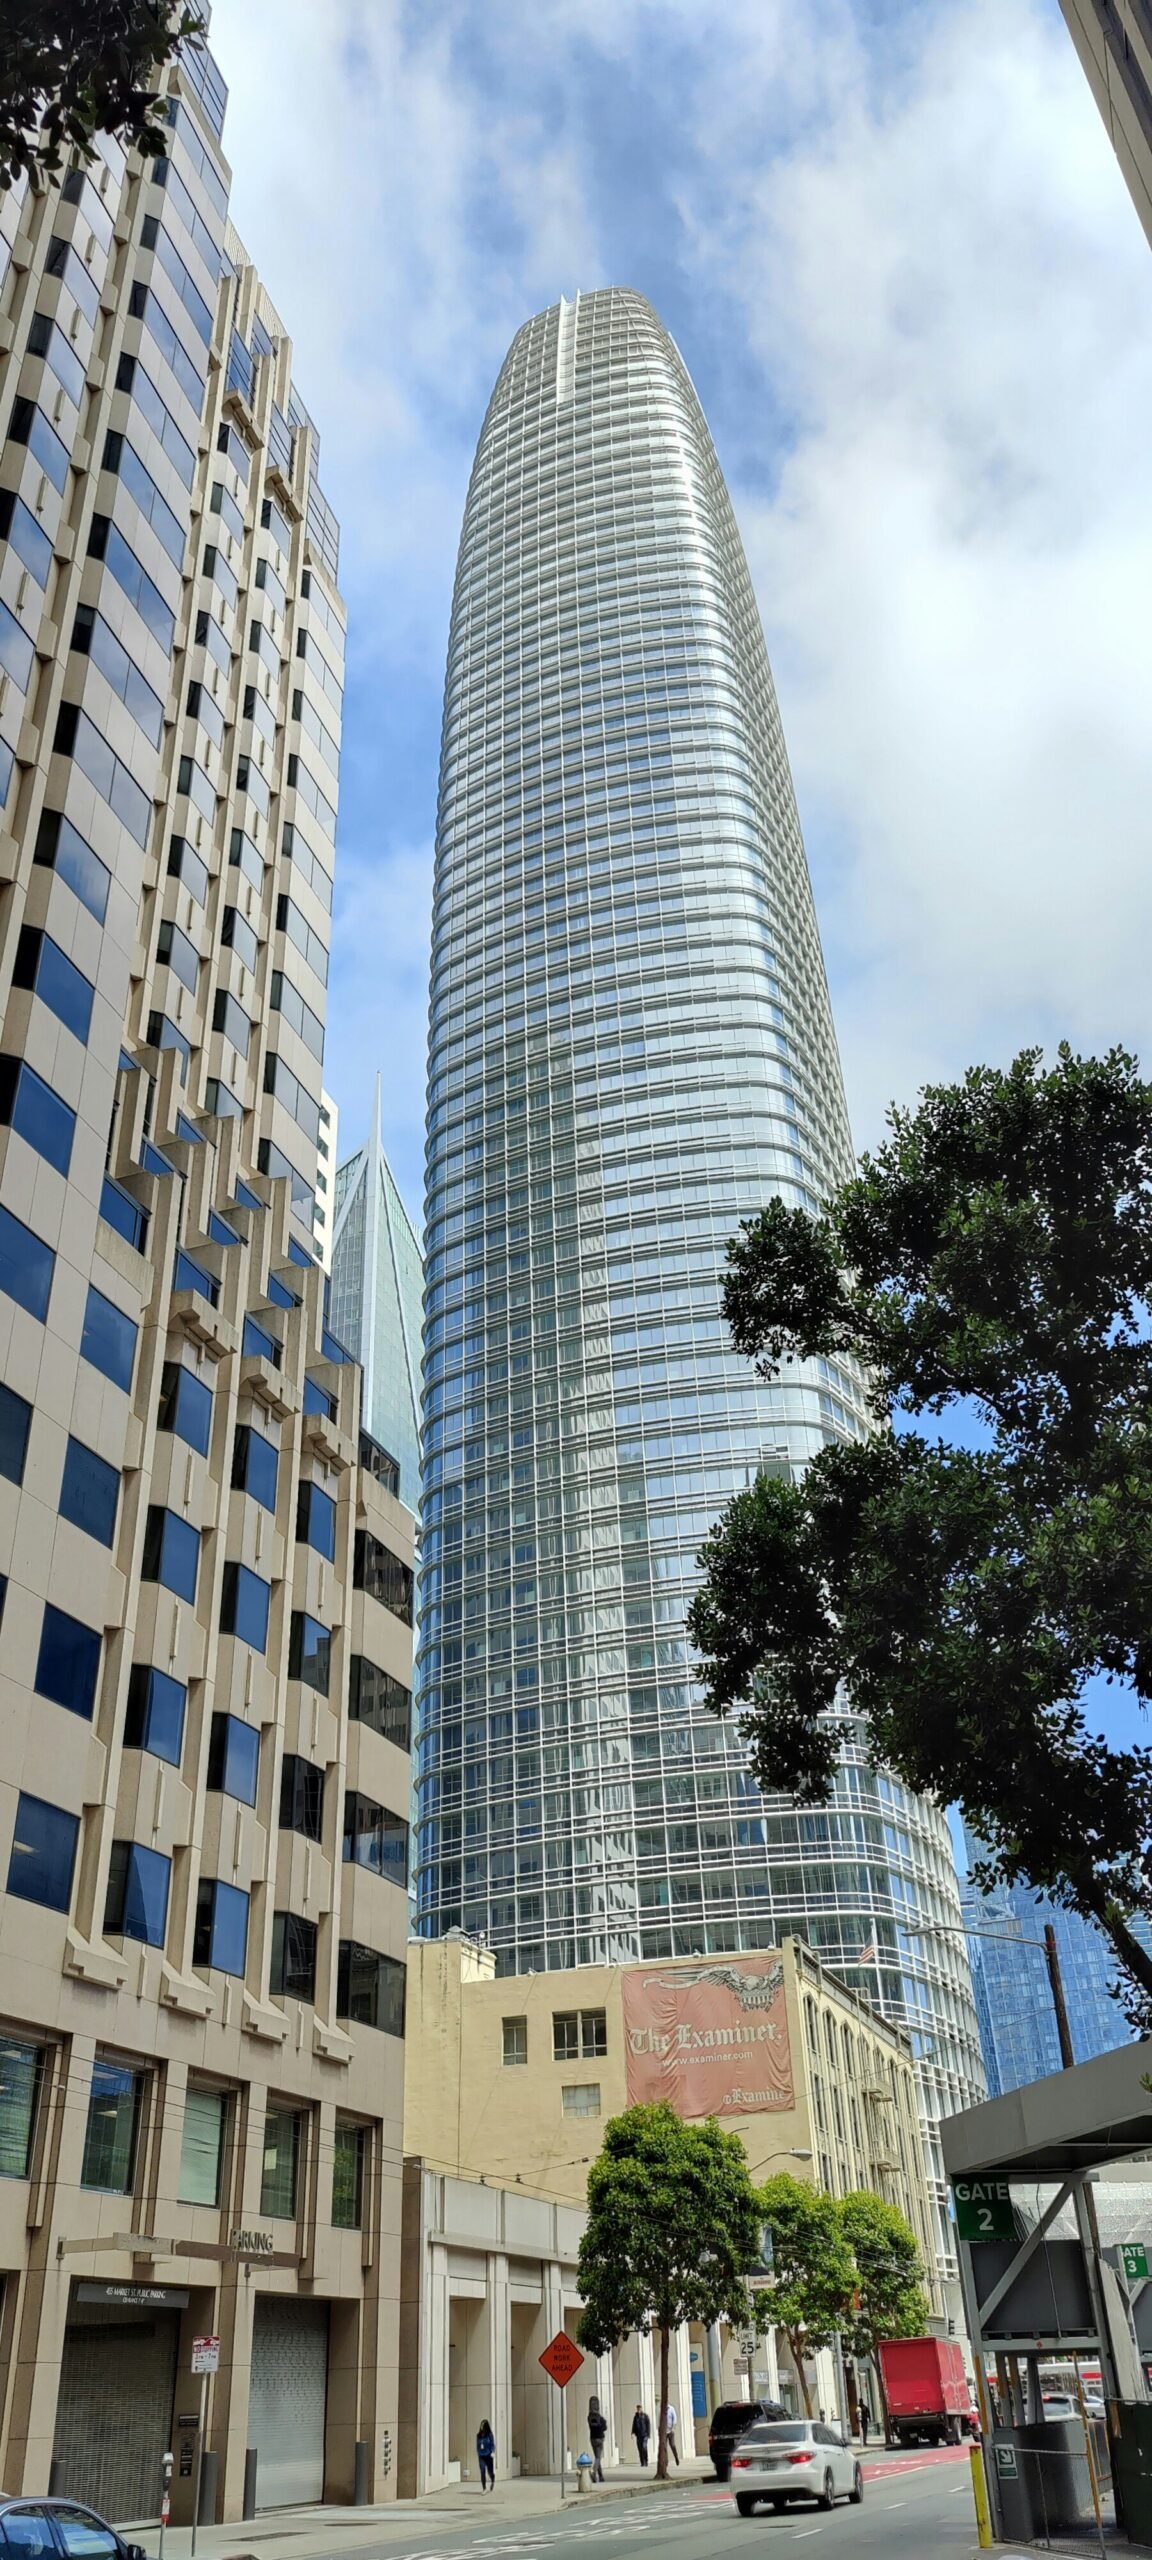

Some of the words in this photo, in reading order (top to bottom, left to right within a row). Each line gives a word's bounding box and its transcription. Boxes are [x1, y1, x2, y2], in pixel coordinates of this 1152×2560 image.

[629, 2024, 671, 2055] The
[674, 2020, 783, 2049] Examiner.
[662, 2051, 753, 2067] www.examiner.com
[955, 2182, 1009, 2201] GATE
[976, 2208, 995, 2231] 2
[231, 2229, 273, 2252] PARKING
[1121, 2247, 1145, 2257] ATE
[1128, 2260, 1138, 2272] 3
[114, 2287, 131, 2297] MARKET
[740, 2332, 753, 2340] LIMIT
[553, 2344, 570, 2352] ROAD
[741, 2341, 754, 2354] 25
